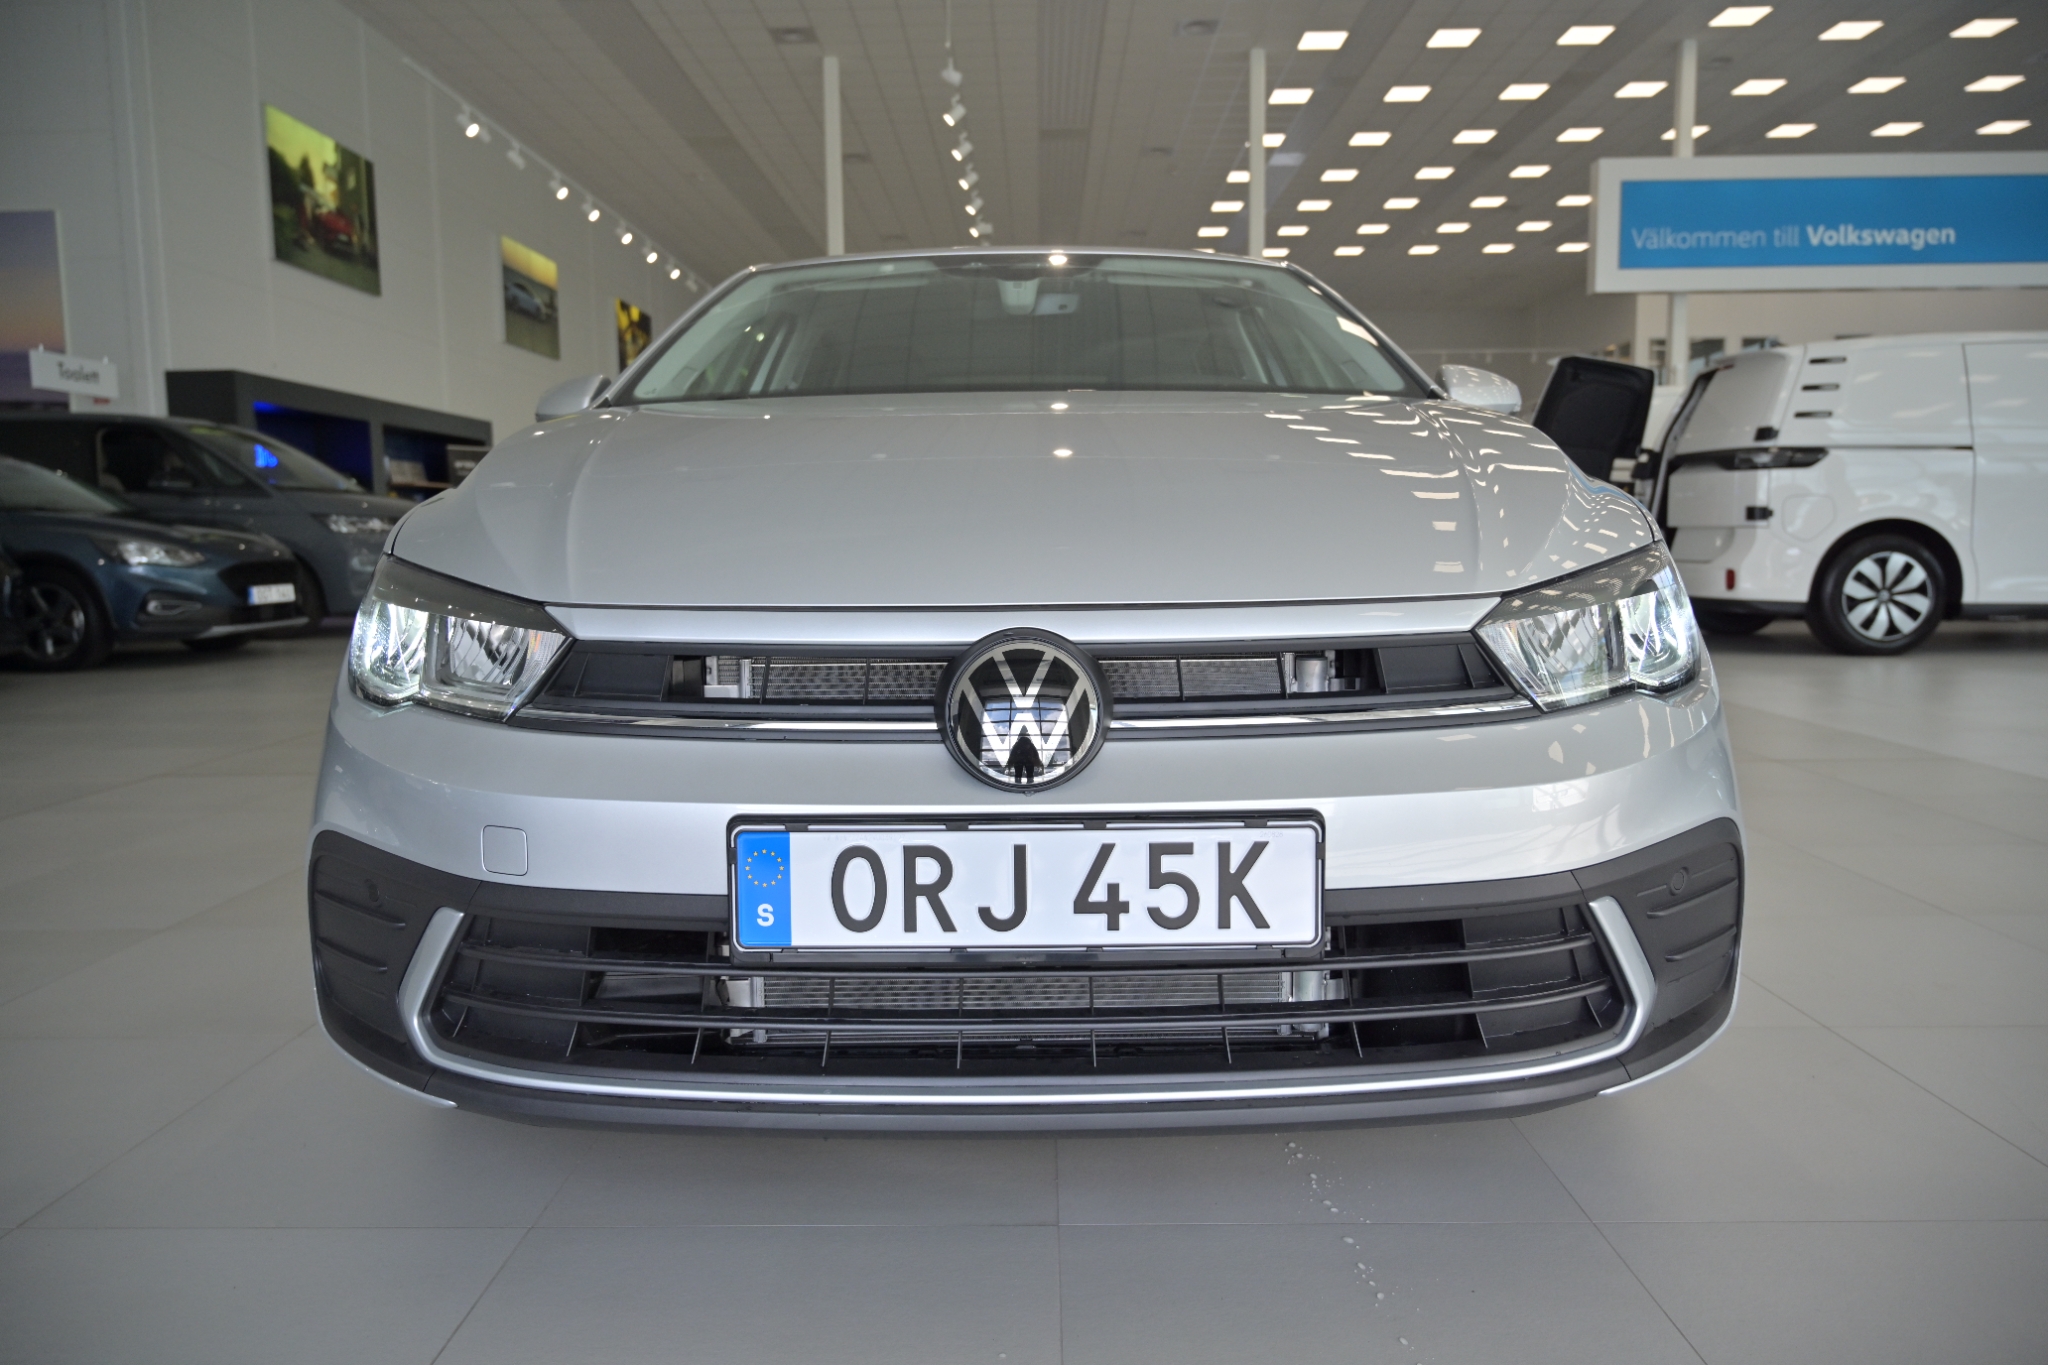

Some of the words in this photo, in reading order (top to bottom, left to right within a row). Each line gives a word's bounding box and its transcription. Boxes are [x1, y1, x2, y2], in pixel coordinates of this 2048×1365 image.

[1631, 227, 1767, 250] Välkommen
[1773, 225, 1800, 247] till
[1806, 224, 1957, 251] Volkswagen
[831, 843, 1028, 934] ORJ
[1073, 840, 1271, 932] 45K
[755, 902, 775, 928] S
